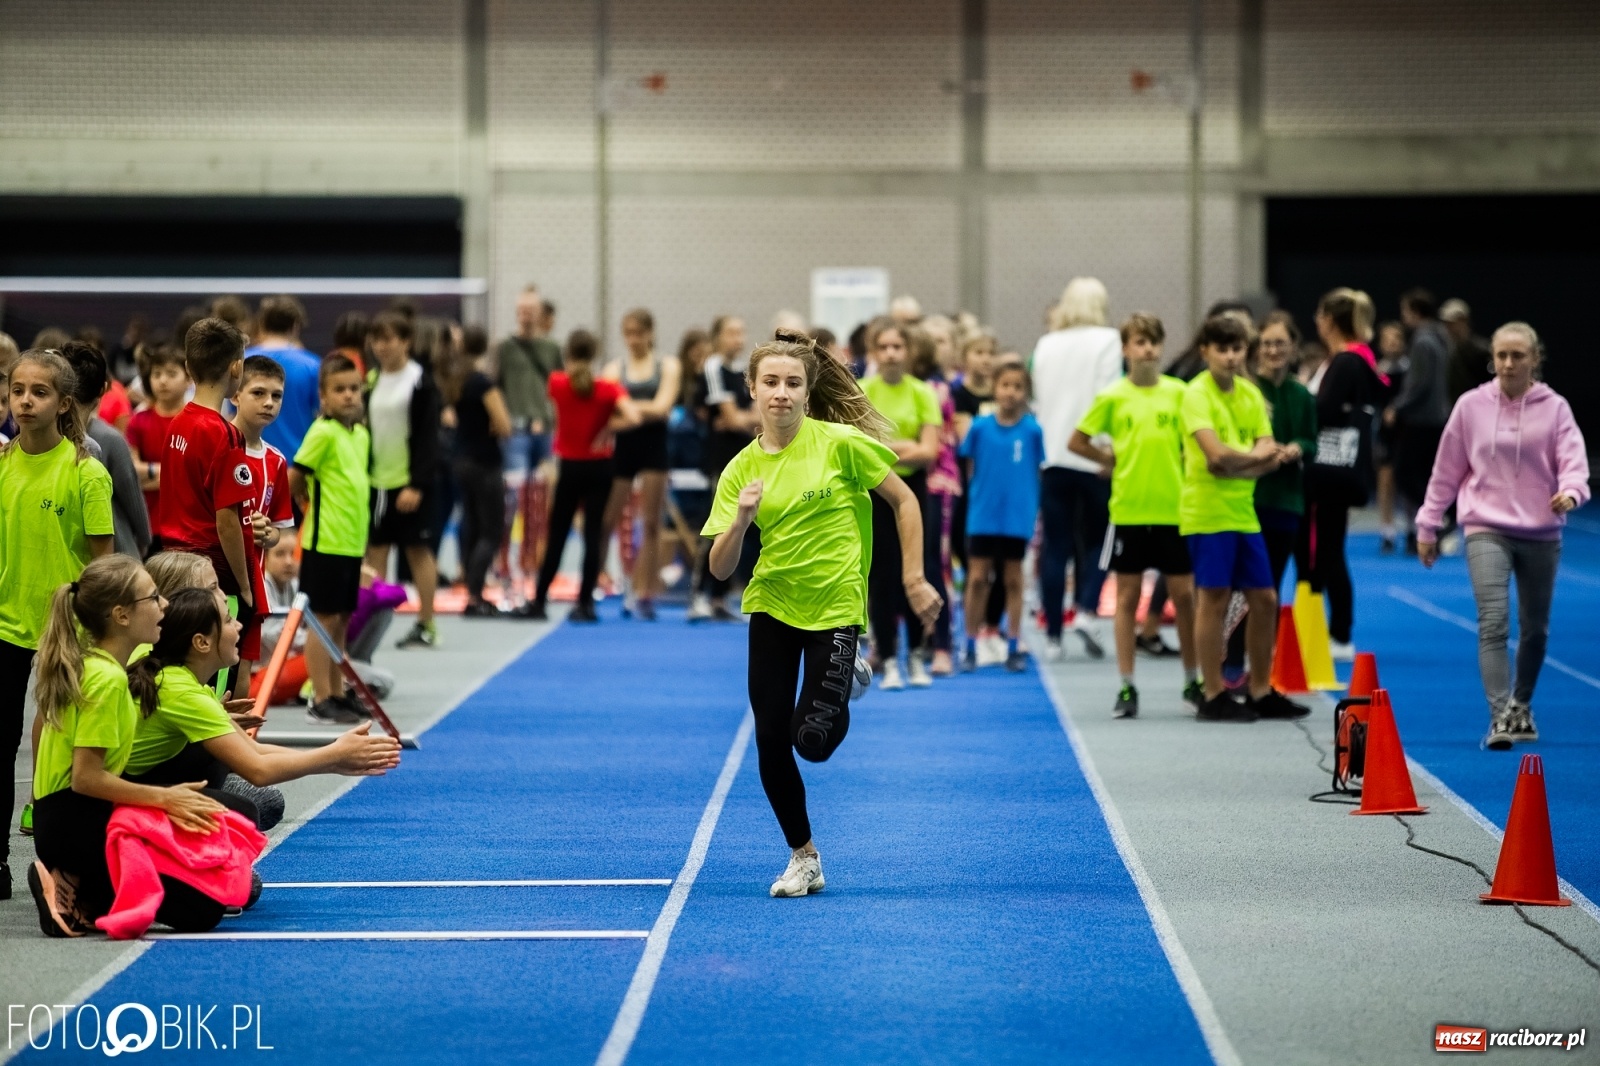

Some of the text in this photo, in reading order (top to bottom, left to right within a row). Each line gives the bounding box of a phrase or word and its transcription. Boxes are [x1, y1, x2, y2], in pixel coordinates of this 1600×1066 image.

[802, 487, 832, 502] SP 18
[821, 626, 856, 702] TART
